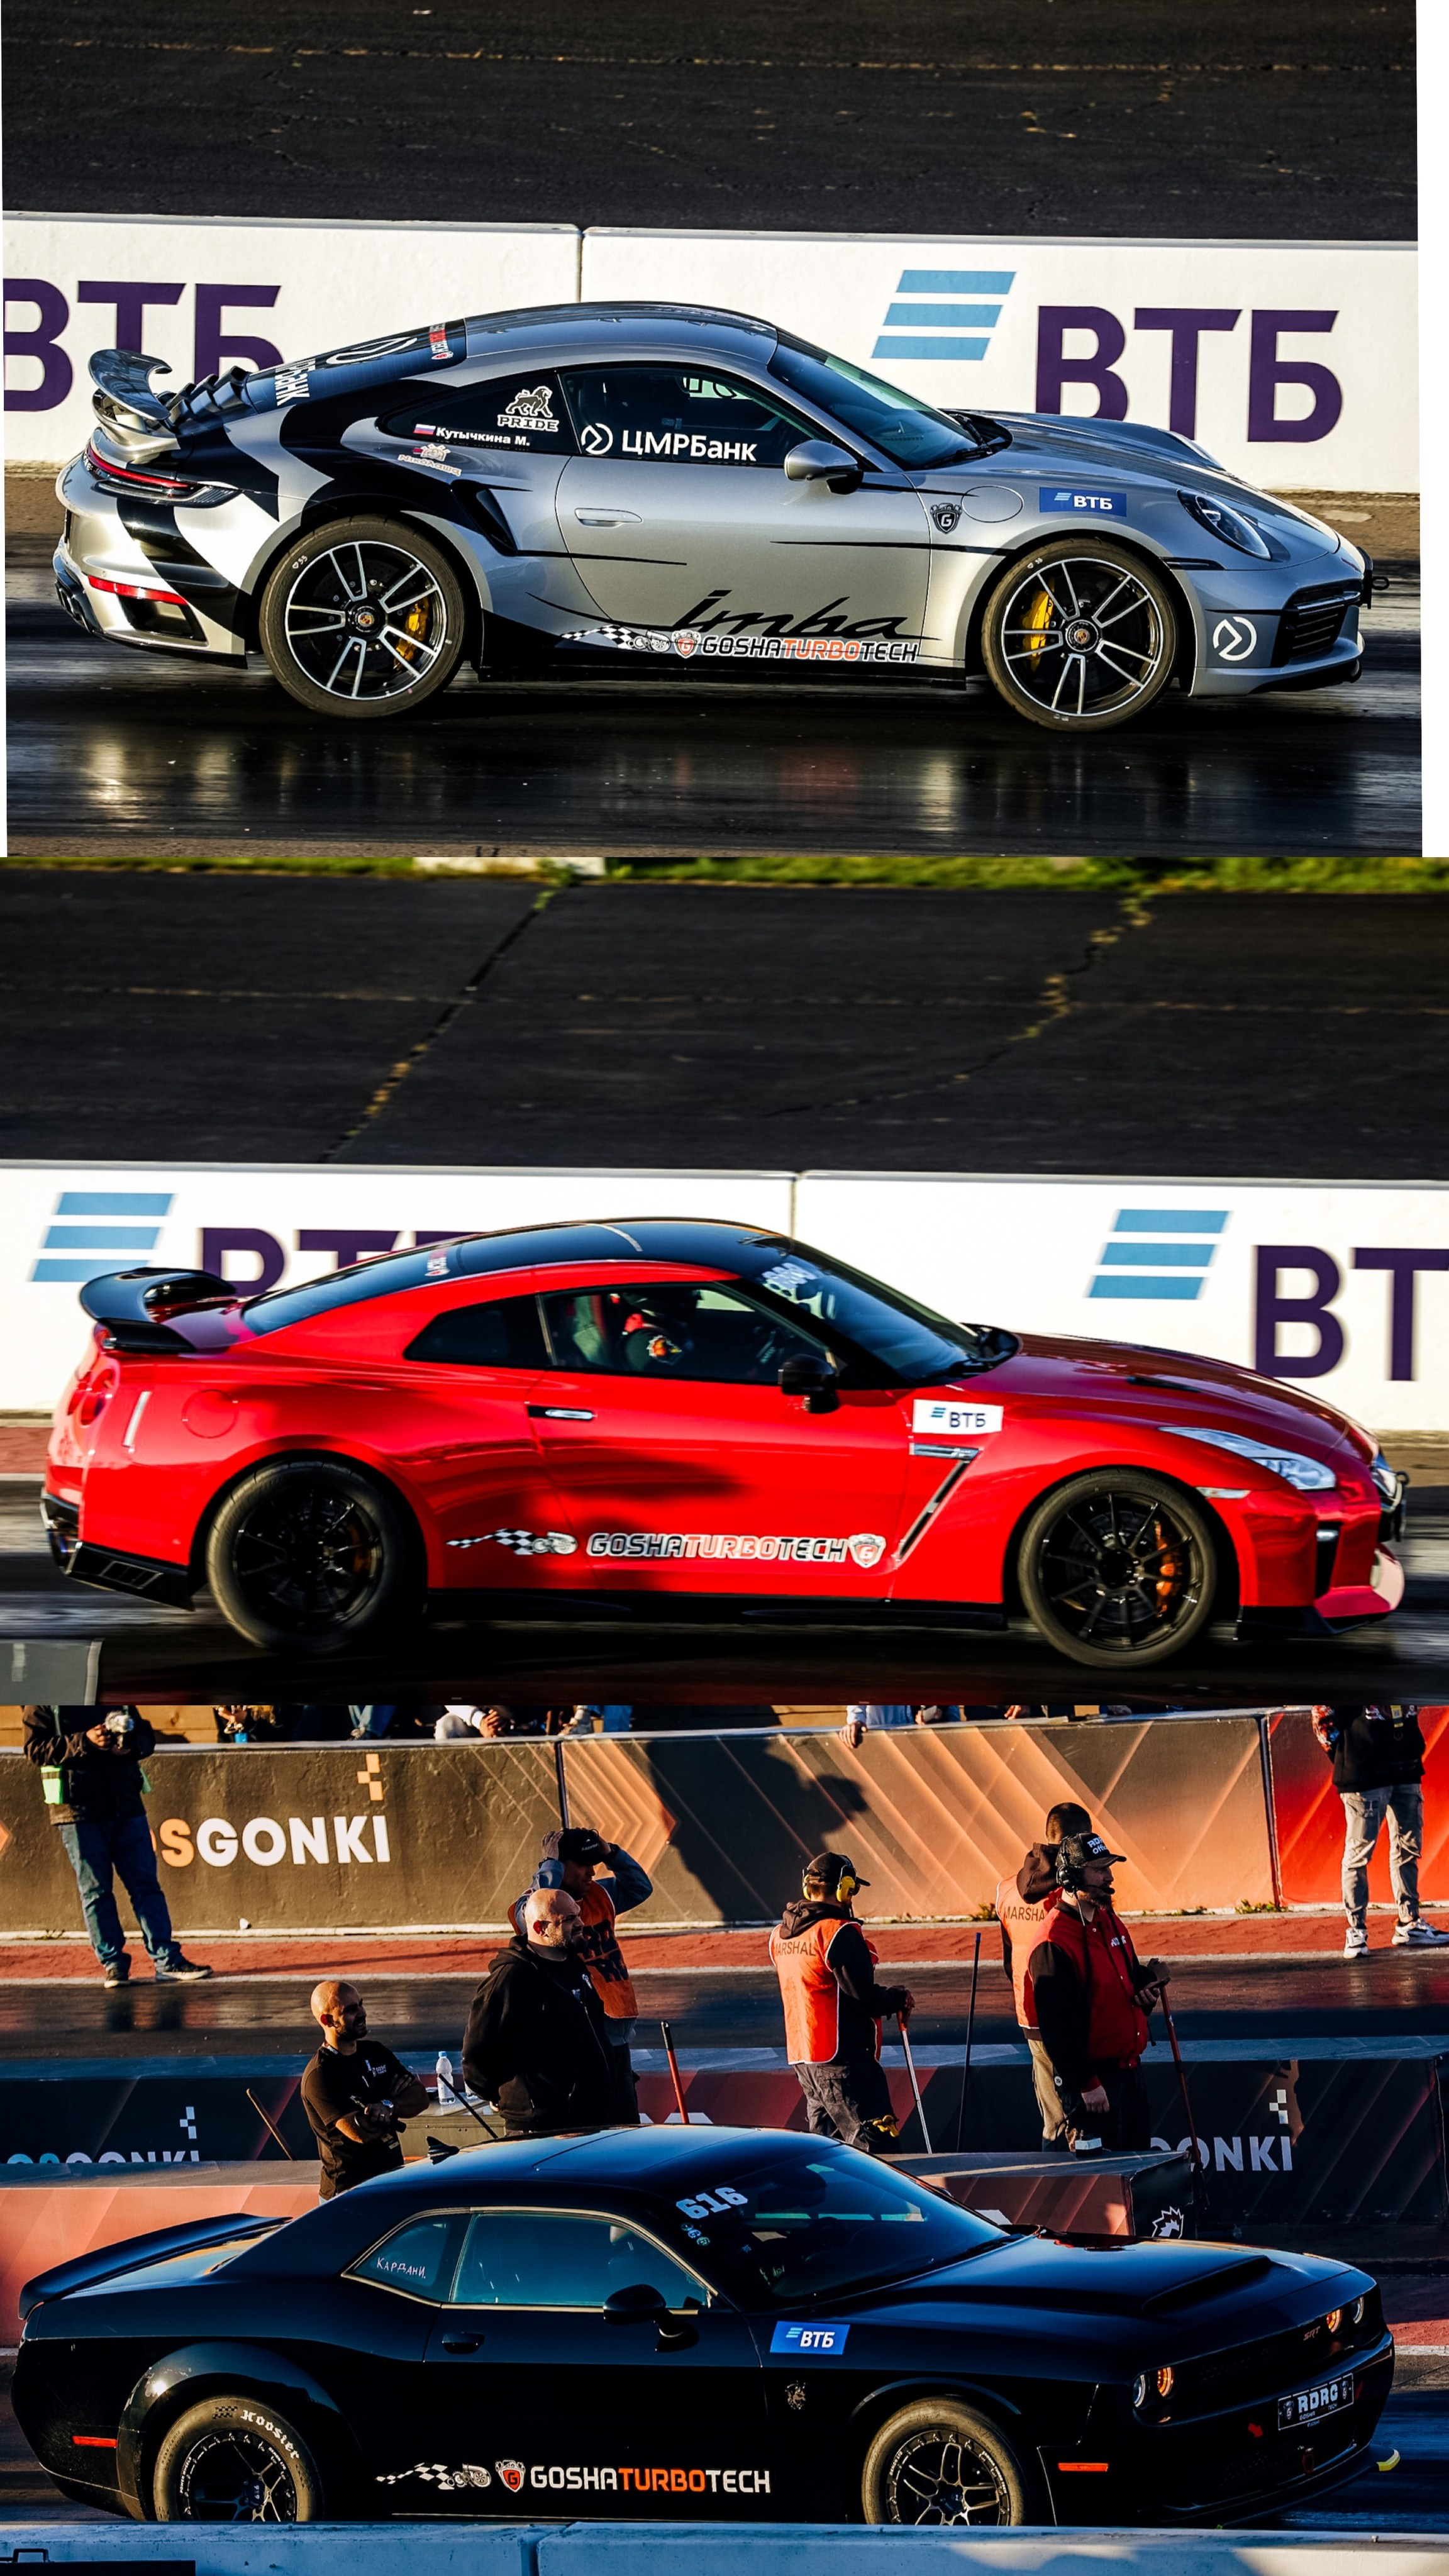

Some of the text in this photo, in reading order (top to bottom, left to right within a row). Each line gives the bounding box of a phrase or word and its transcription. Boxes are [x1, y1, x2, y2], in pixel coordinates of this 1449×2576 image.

[3, 279, 285, 411] ВТБ
[1035, 306, 1343, 443] ВТБ
[436, 427, 531, 446] Кутычкина М.
[499, 416, 558, 431] PRIDE
[622, 430, 757, 461] ЦМРБанк
[1074, 495, 1113, 510] ВТБ
[941, 513, 952, 527] G
[672, 589, 912, 640] imba
[702, 634, 919, 662] GOSHATURBOTECH
[950, 1412, 986, 1428] ВТБ
[589, 1533, 847, 1562] GOSHATURBOTECH
[150, 1816, 391, 1867] SGONKI
[1004, 1906, 1045, 1922] MARSHA
[675, 2189, 748, 2219] 616
[800, 2331, 835, 2348] ВТБ
[1303, 2326, 1321, 2341] SRT
[1297, 2384, 1338, 2414] RDRC
[240, 2409, 299, 2459] Hoosier
[531, 2466, 772, 2494] GOSHATURBOTECH
